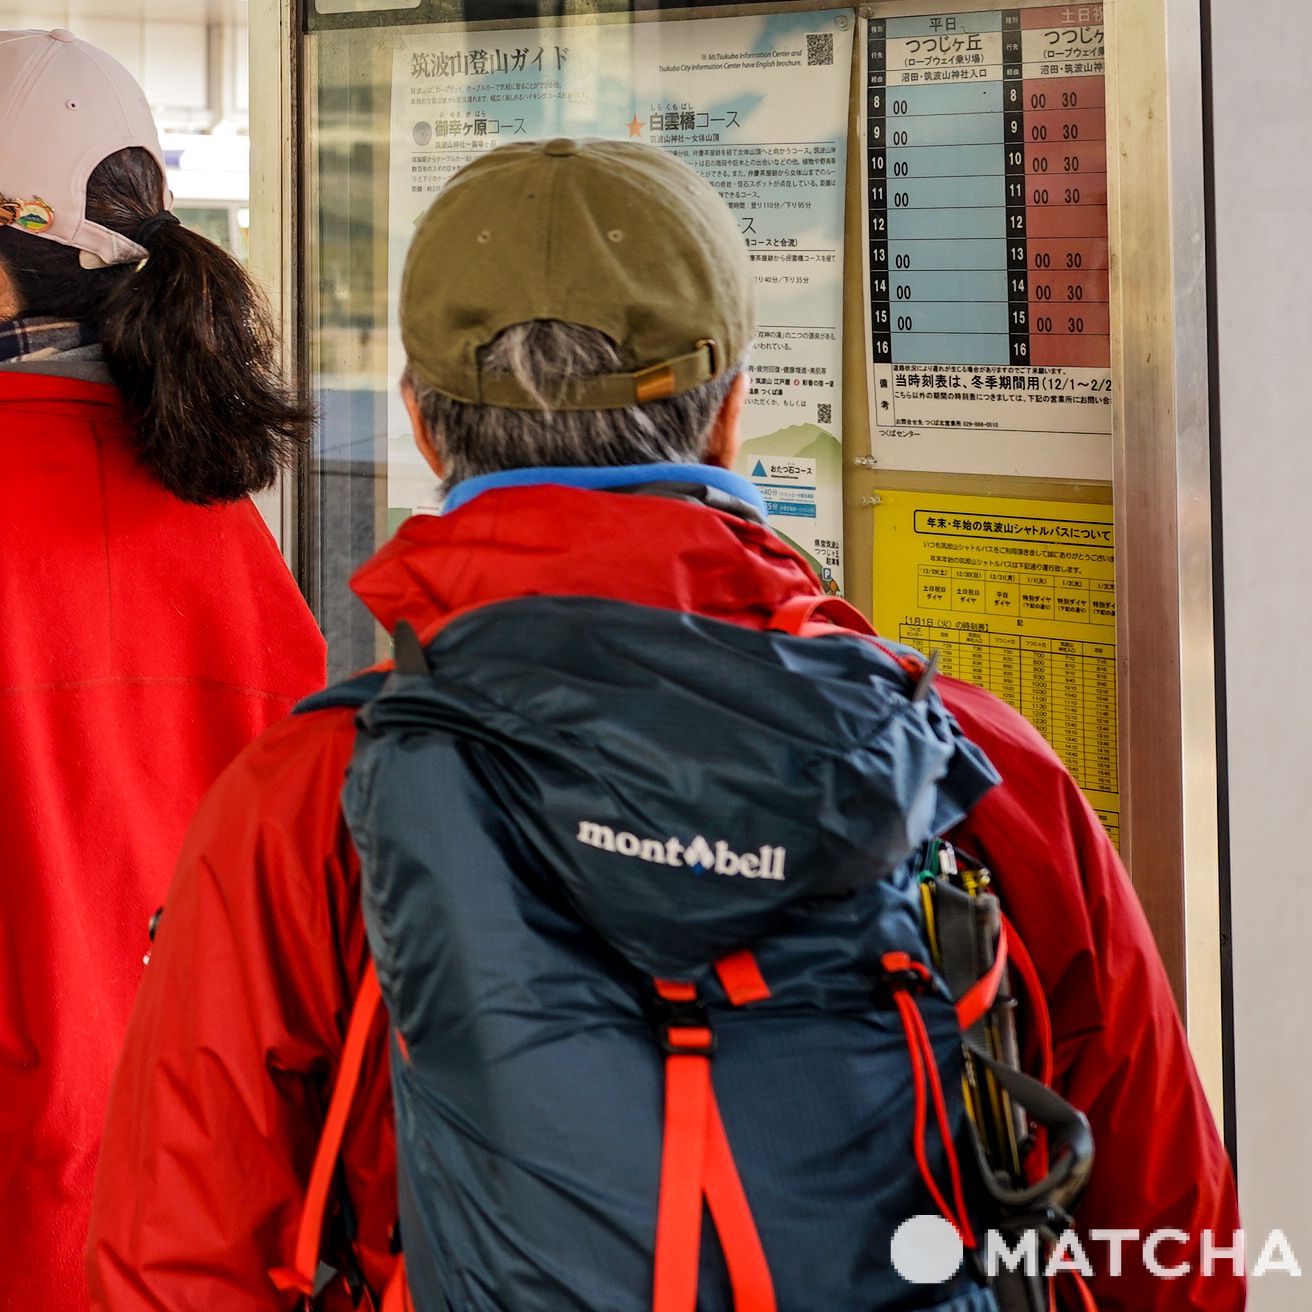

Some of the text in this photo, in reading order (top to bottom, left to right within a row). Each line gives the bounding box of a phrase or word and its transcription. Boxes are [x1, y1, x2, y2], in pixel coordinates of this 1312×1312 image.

[929, 18, 956, 32] 平日
[1006, 42, 1018, 51] 行先
[739, 51, 771, 59] Information
[772, 50, 789, 58] Center
[790, 49, 802, 57] and
[411, 46, 570, 79] 筑波山登山ガイド
[691, 63, 723, 71] Information
[756, 61, 775, 69] English
[1010, 89, 1017, 101] 8
[1031, 92, 1077, 109] 00 30
[874, 96, 880, 108] 8
[893, 101, 907, 114] 00
[650, 111, 740, 131] 白雲橋コース
[1011, 121, 1017, 133] 9
[874, 127, 880, 139] 9
[893, 131, 907, 145] 00
[1032, 124, 1078, 140] 00 30
[871, 157, 883, 169] 10
[1009, 153, 1021, 165] 10
[1033, 156, 1079, 172] 00 30
[894, 162, 908, 176] 00
[872, 188, 883, 200] 11
[1010, 184, 1021, 197] 11
[1034, 188, 1080, 204] 00 30
[894, 193, 908, 207] 00
[738, 217, 756, 234] ス
[873, 218, 884, 231] 12
[1010, 216, 1023, 229] 12
[873, 249, 885, 261] 13
[1011, 248, 1023, 260] 13
[1035, 253, 1082, 268] 00 30
[896, 255, 910, 268] 00
[874, 280, 886, 292] 14
[1012, 279, 1024, 292] 14
[897, 285, 911, 300] 00
[1036, 285, 1082, 300] 00 30
[876, 310, 887, 323] 15
[1013, 311, 1025, 324] 15
[897, 316, 912, 331] 00
[1037, 317, 1083, 332] 00 30
[752, 343, 792, 351] いわれている。
[876, 341, 888, 354] 16
[1014, 343, 1026, 356] 16
[879, 430, 920, 438] つくばセンター
[771, 465, 812, 474] おたつ石コース
[767, 503, 778, 511] 5分
[577, 820, 786, 880] mont bell
